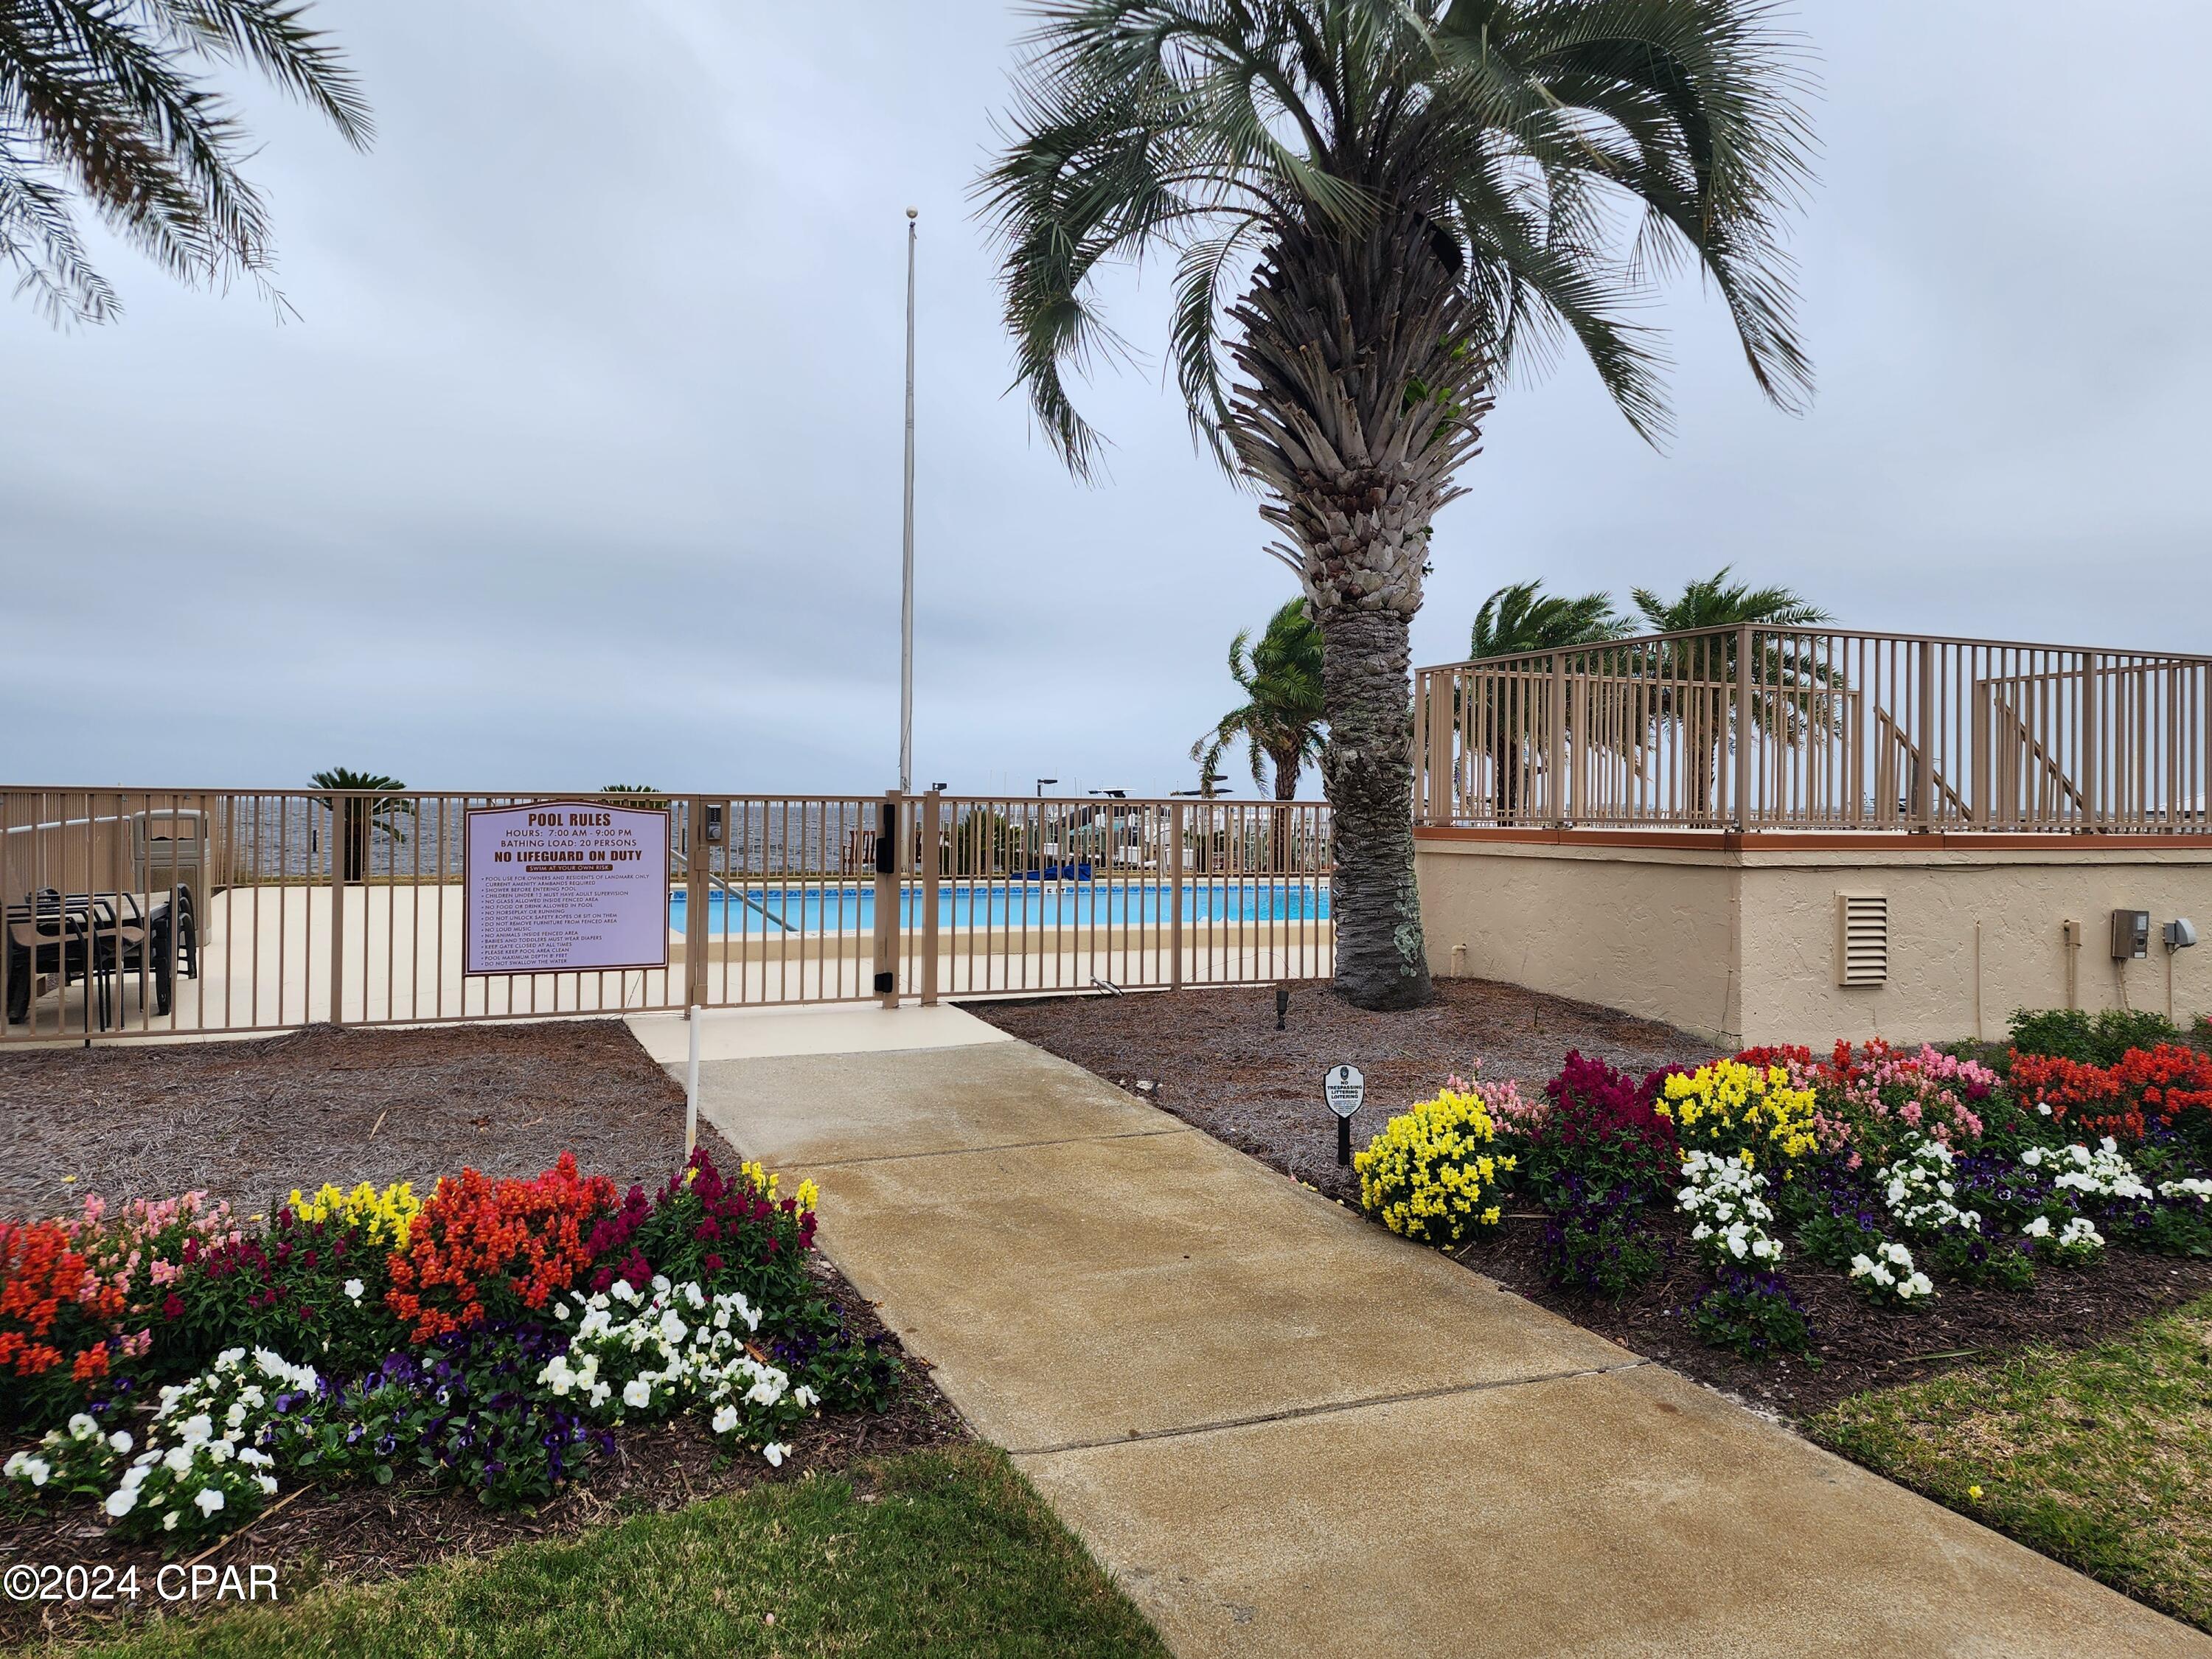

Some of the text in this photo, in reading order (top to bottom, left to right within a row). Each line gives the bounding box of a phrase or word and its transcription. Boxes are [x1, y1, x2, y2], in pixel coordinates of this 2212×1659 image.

[528, 813, 611, 826] POOL RULES
[495, 851, 642, 862] NO LIFEGUARD ON DUTY
